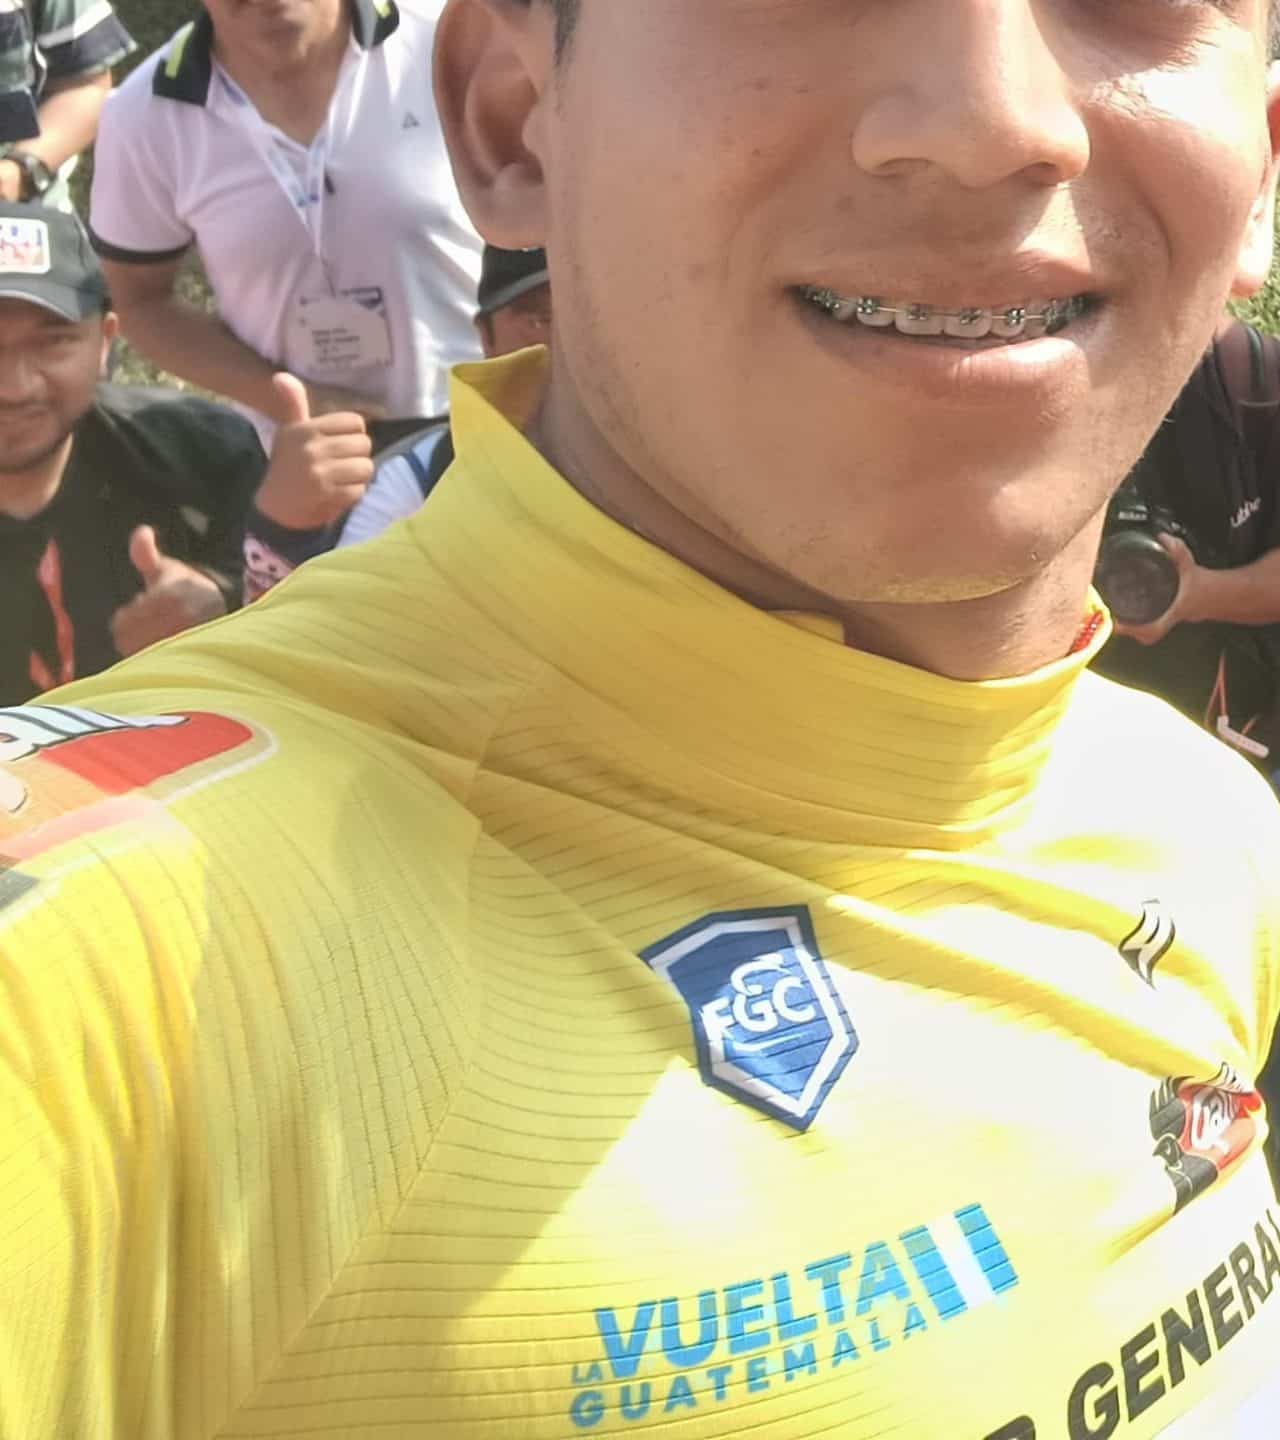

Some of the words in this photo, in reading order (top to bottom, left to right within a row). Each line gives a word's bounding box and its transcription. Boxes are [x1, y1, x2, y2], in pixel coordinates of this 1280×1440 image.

[701, 974, 818, 1055] FGC
[594, 1239, 911, 1379] VUELTA
[569, 1301, 930, 1429] GUATEMALA
[571, 1358, 604, 1386] LA
